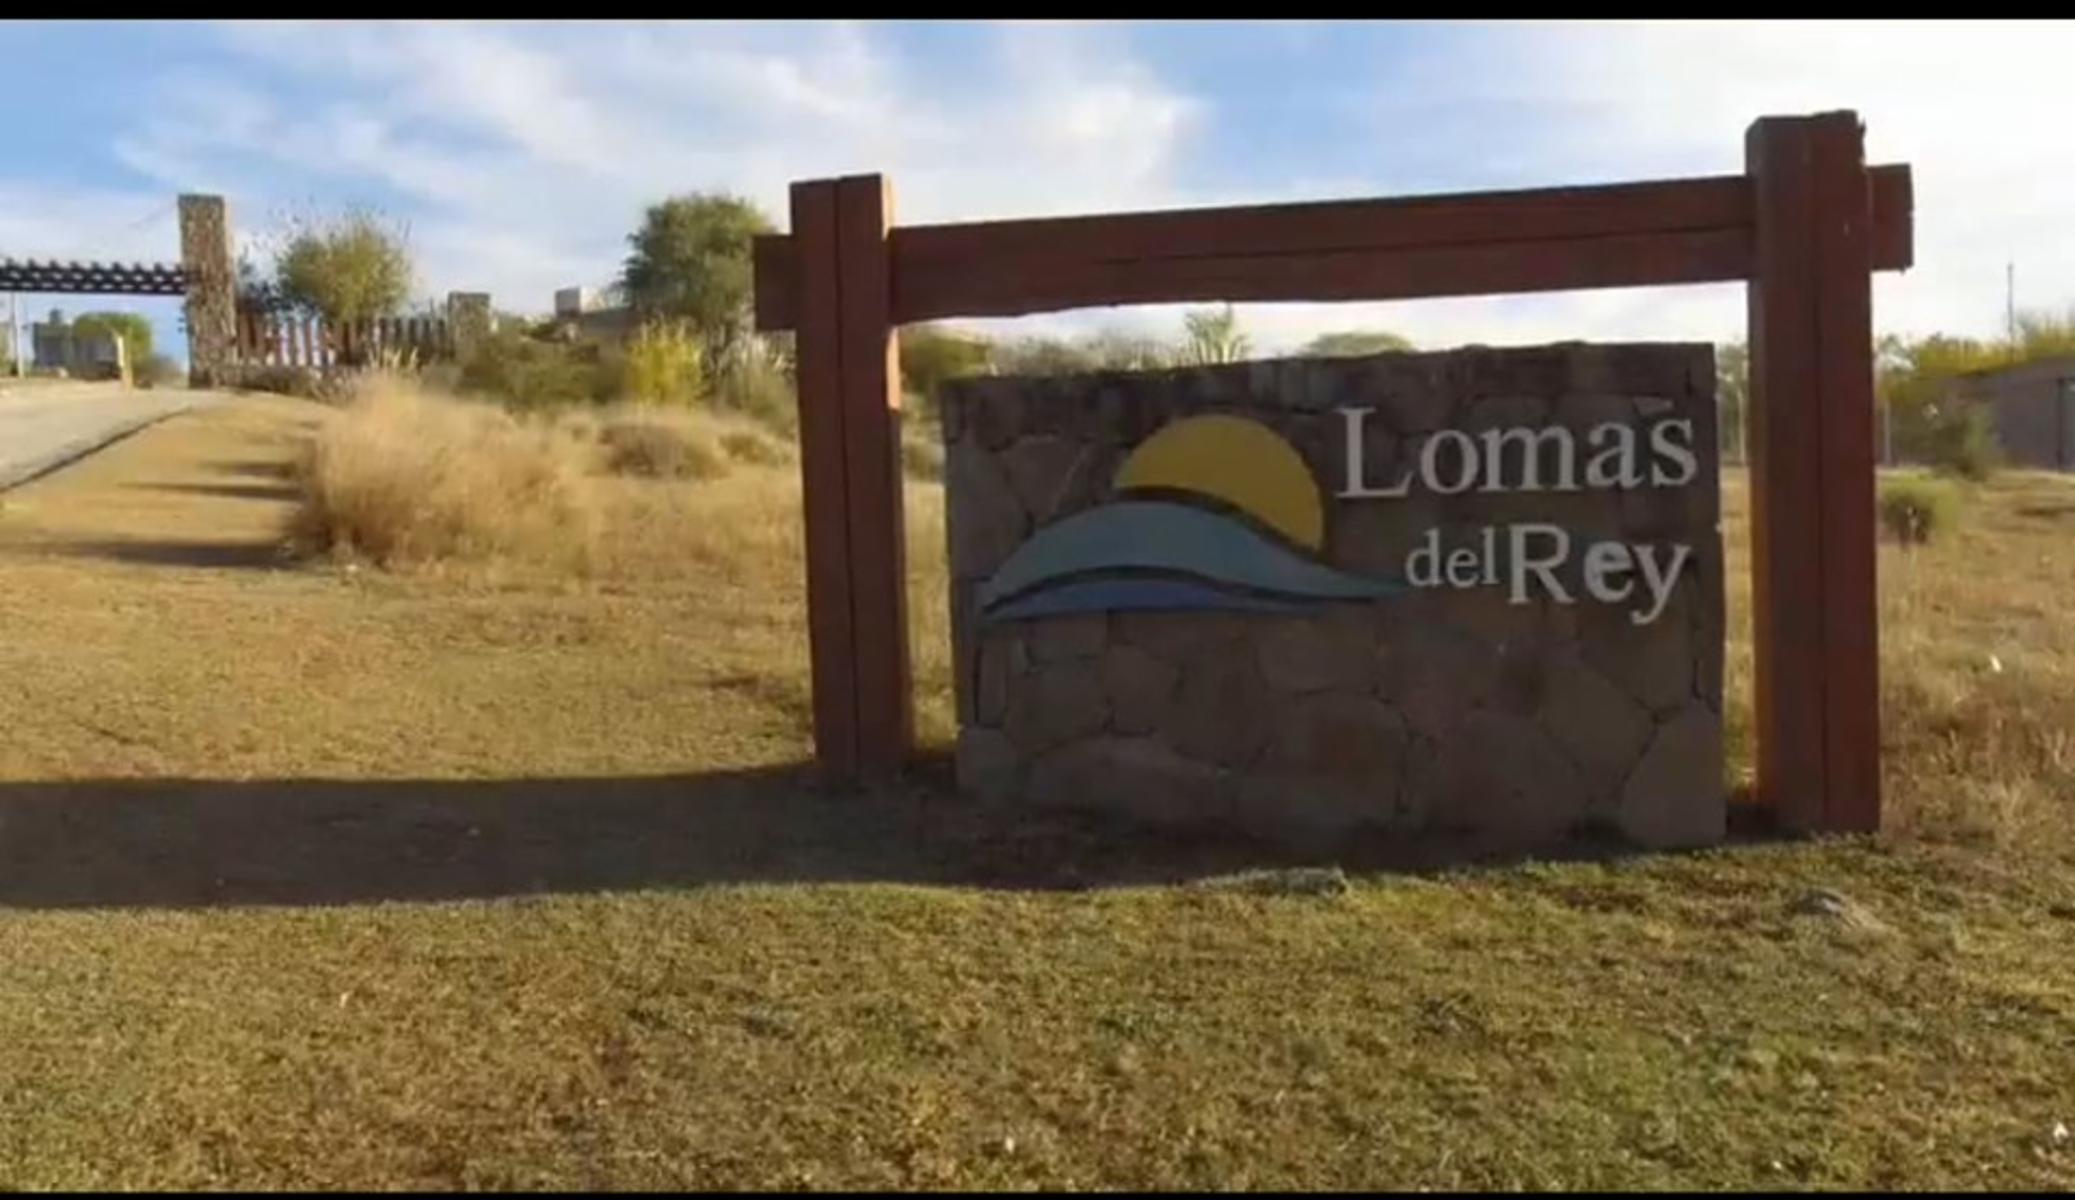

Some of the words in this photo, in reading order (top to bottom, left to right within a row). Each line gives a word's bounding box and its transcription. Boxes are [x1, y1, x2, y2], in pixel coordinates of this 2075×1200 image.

[1335, 405, 1698, 499] Lomas
[1405, 526, 1500, 589] del
[1508, 522, 1693, 626] Rey
